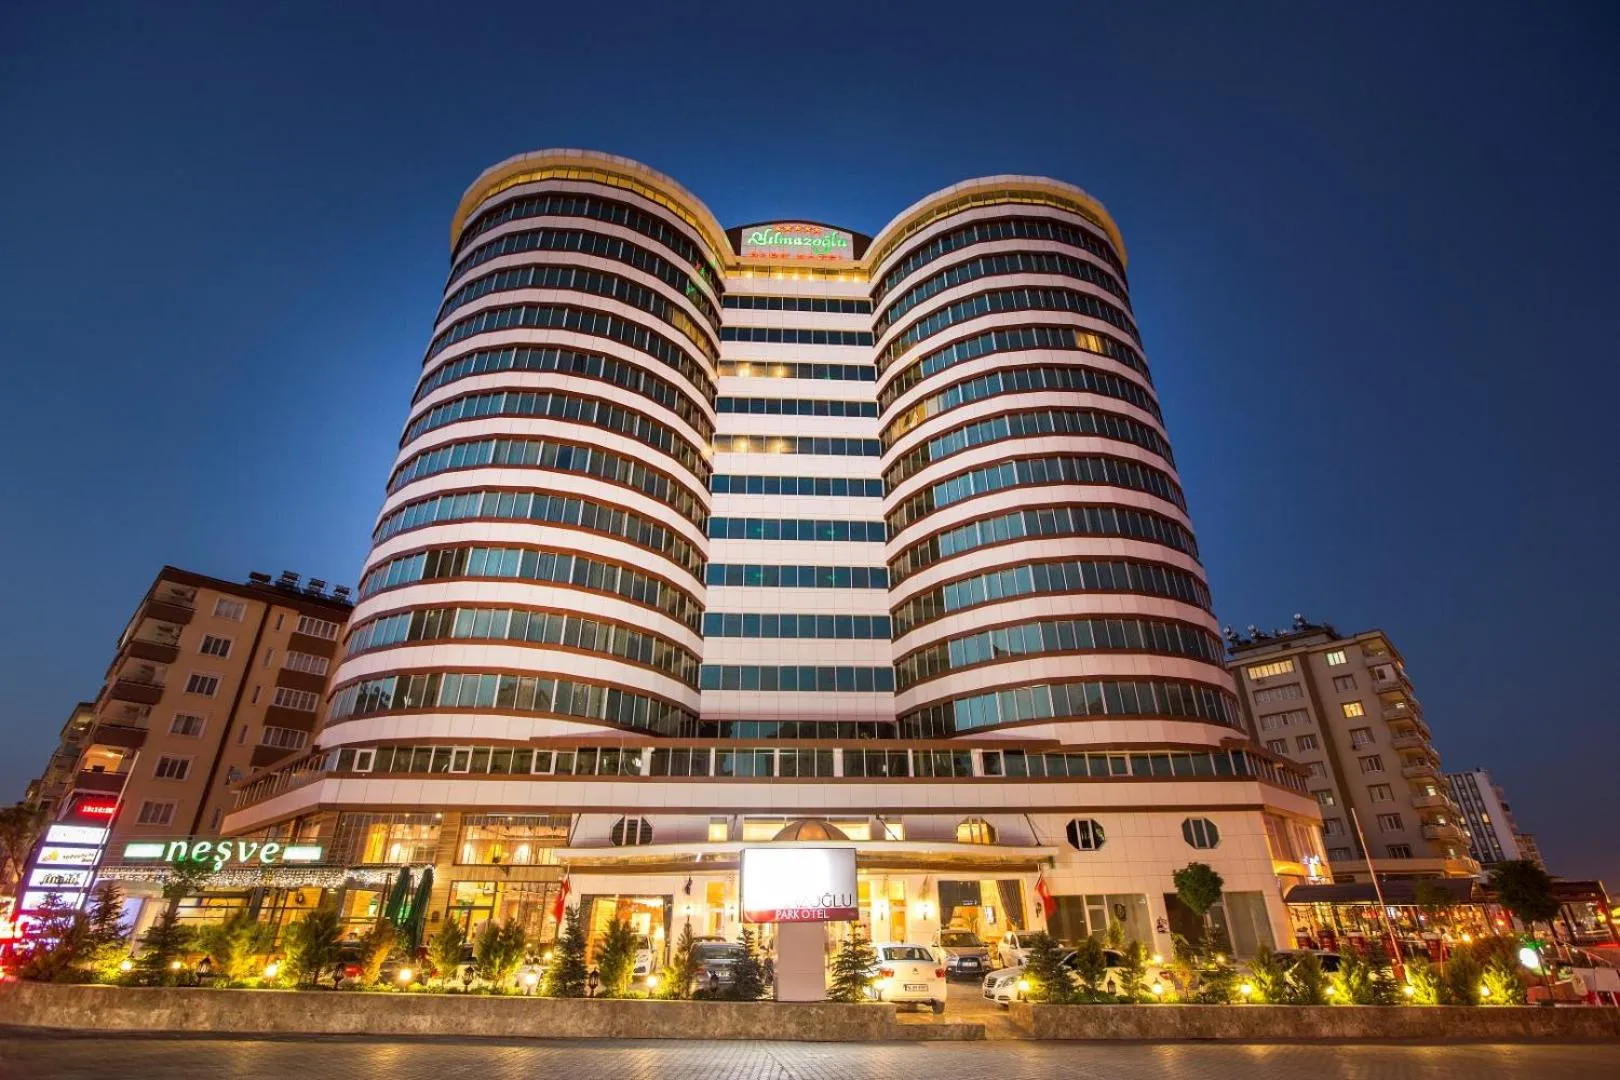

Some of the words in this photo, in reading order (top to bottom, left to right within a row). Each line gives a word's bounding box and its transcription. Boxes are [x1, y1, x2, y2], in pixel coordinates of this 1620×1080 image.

[164, 840, 280, 871] neşve
[775, 908, 799, 920] PARK
[801, 908, 830, 919] OTEL
